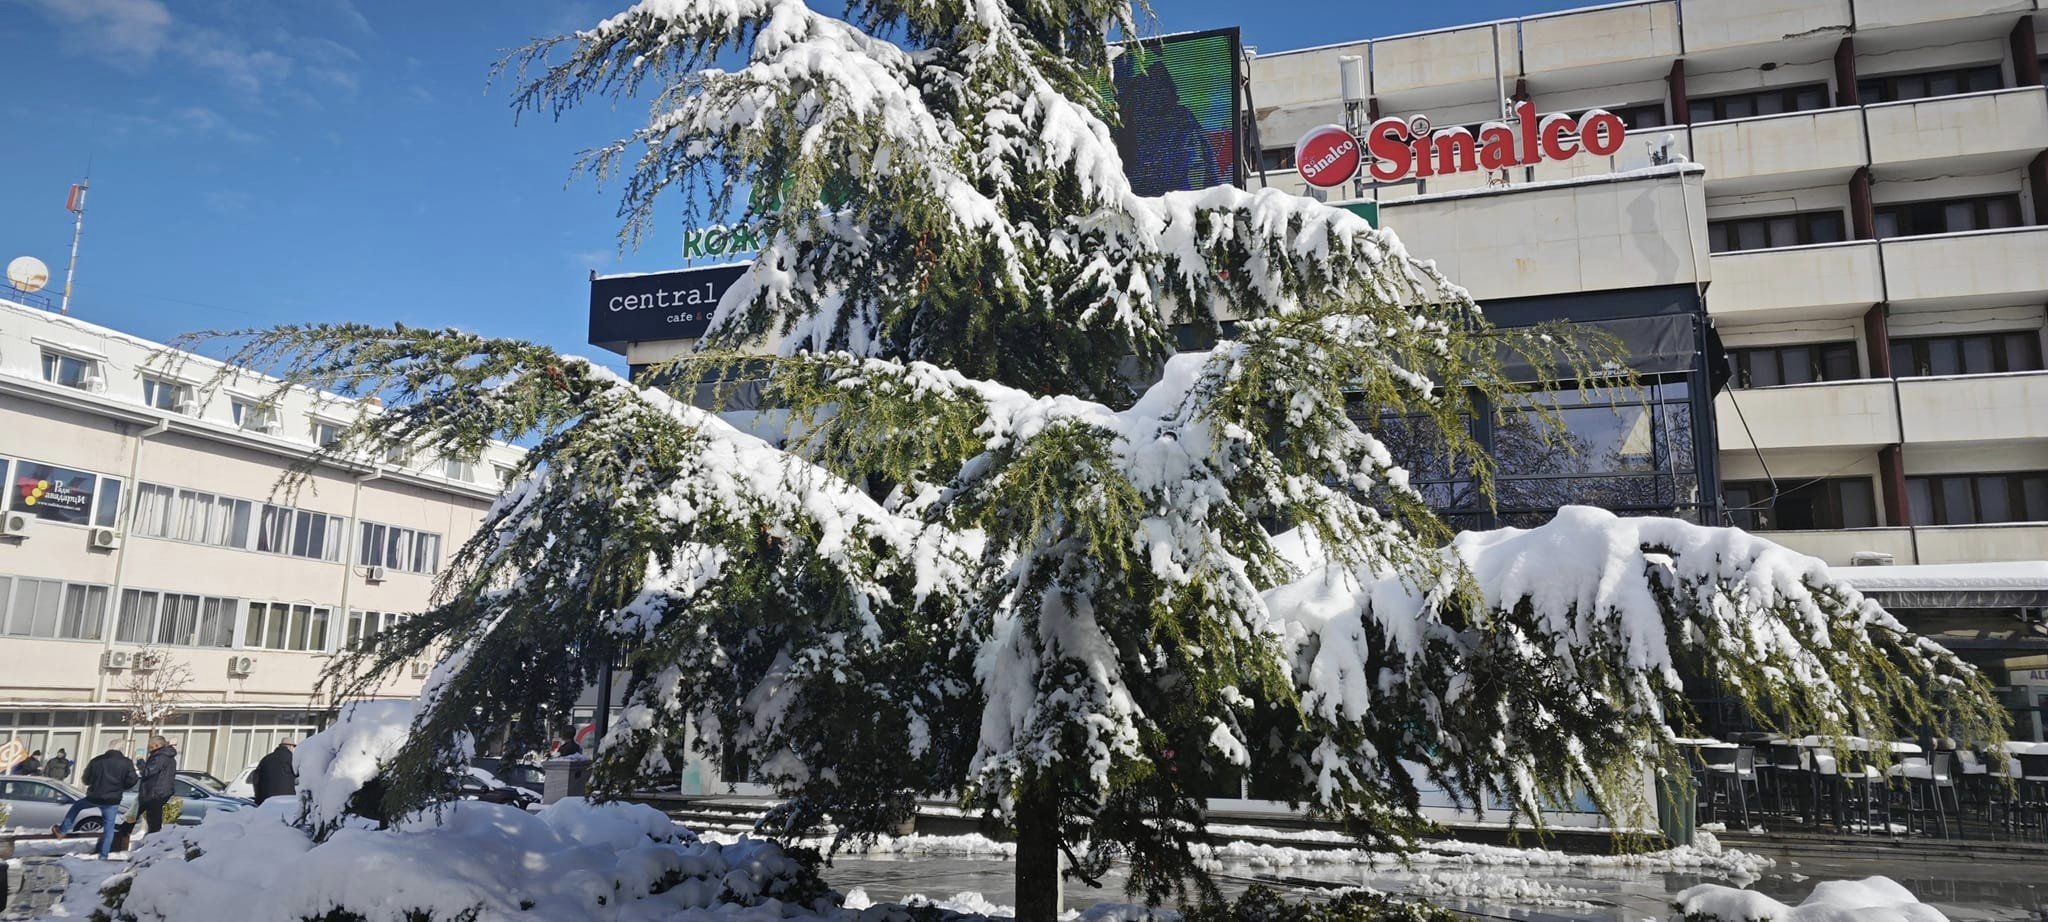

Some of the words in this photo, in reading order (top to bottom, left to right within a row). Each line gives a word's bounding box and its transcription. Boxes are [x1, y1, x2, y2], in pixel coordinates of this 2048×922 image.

[1368, 99, 1626, 182] Sinalco
[1302, 139, 1354, 178] Sinalco
[608, 282, 717, 312] central
[666, 312, 693, 323] cafe
